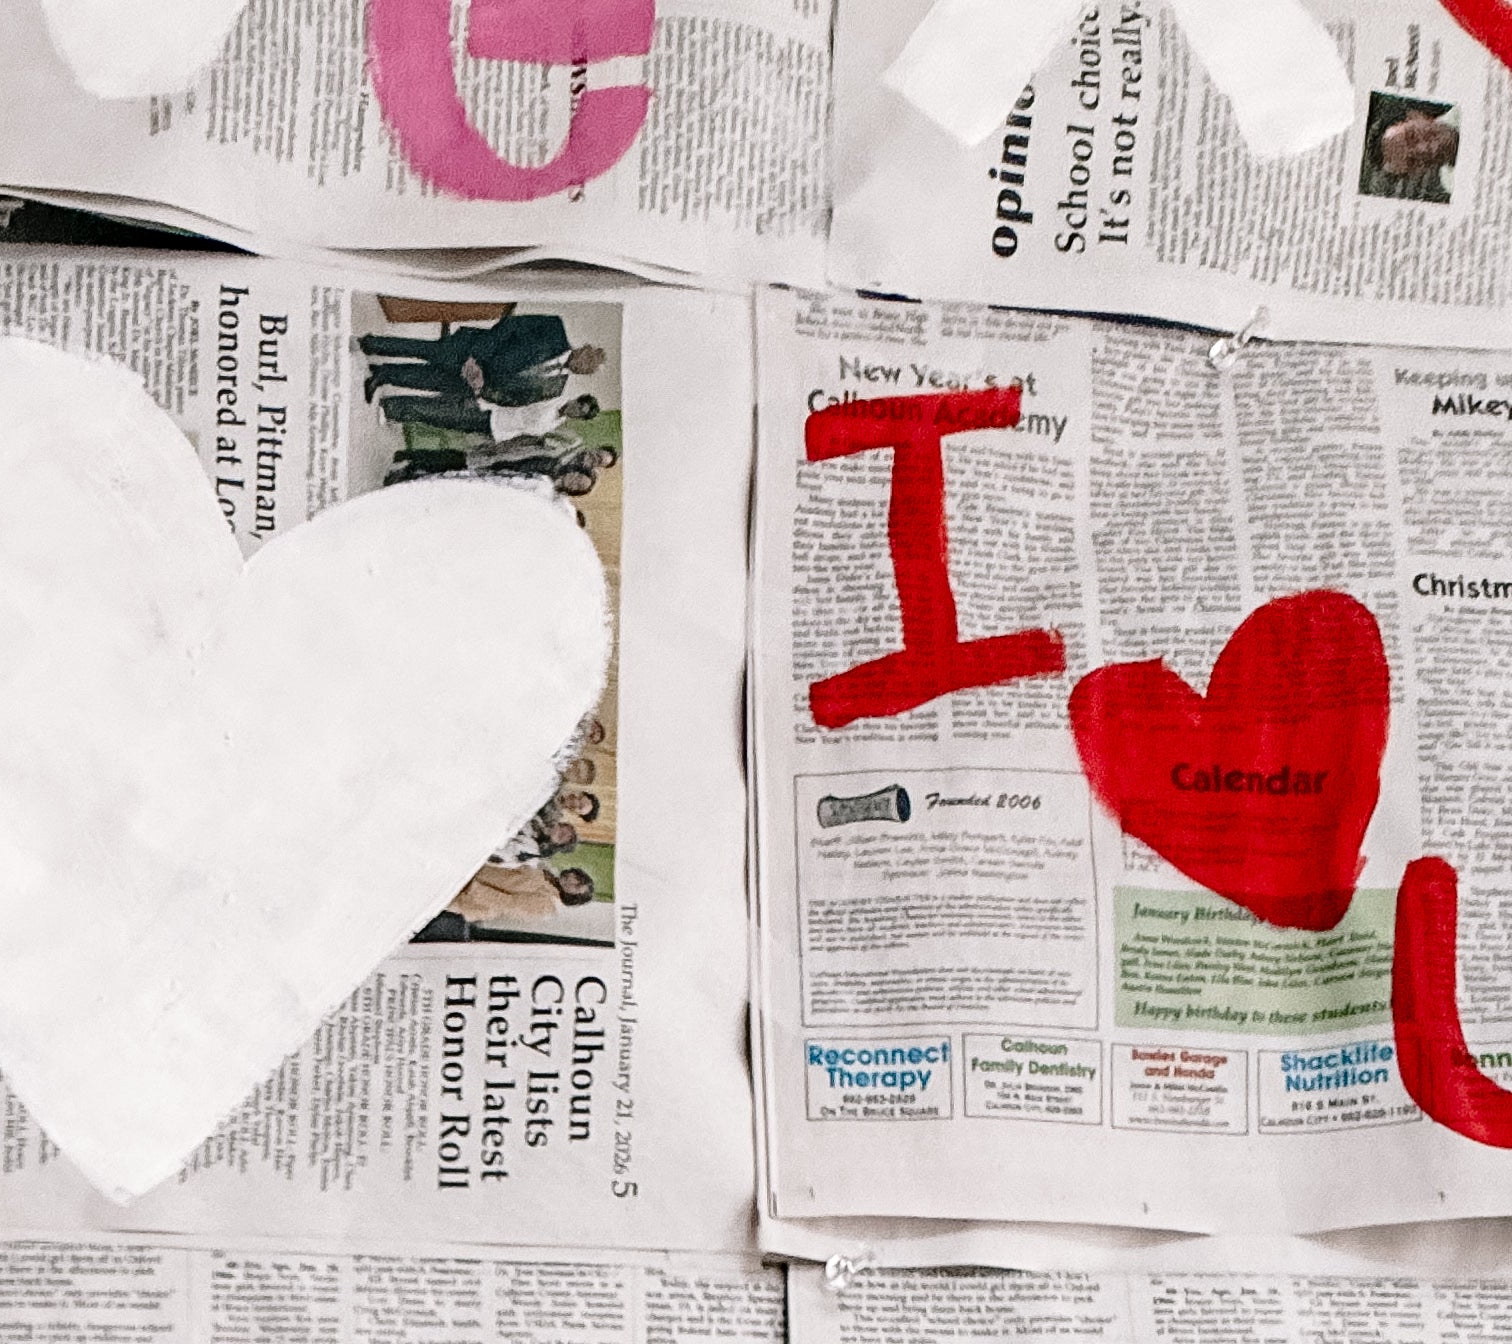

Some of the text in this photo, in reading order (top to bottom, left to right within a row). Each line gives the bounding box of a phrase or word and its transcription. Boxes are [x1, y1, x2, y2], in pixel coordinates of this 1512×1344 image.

[1054, 124, 1094, 254] School
[1098, 110, 1139, 246] It's not
[216, 283, 250, 465] honored at
[839, 355, 901, 384] New
[249, 313, 288, 541] Burl, Pittman,
[804, 383, 1066, 728] I
[996, 793, 1042, 810] 2006
[620, 904, 638, 936] The
[619, 940, 639, 1011] Journal,
[1134, 1000, 1266, 1024] Happy birthday to
[519, 974, 565, 1148] City lists
[568, 975, 607, 1143] Calhoun
[611, 1014, 638, 1102] January
[808, 1041, 950, 1067] Reconnect
[970, 1056, 1096, 1081] Family Dentistry
[1000, 1037, 1069, 1056] Calhoun
[437, 974, 477, 1191] Honor Roll
[479, 975, 521, 1182] their latest
[826, 1067, 932, 1092] Therapy
[1285, 1067, 1388, 1093] Nutrition
[615, 1099, 634, 1125] 21,
[611, 1180, 639, 1199] 5
